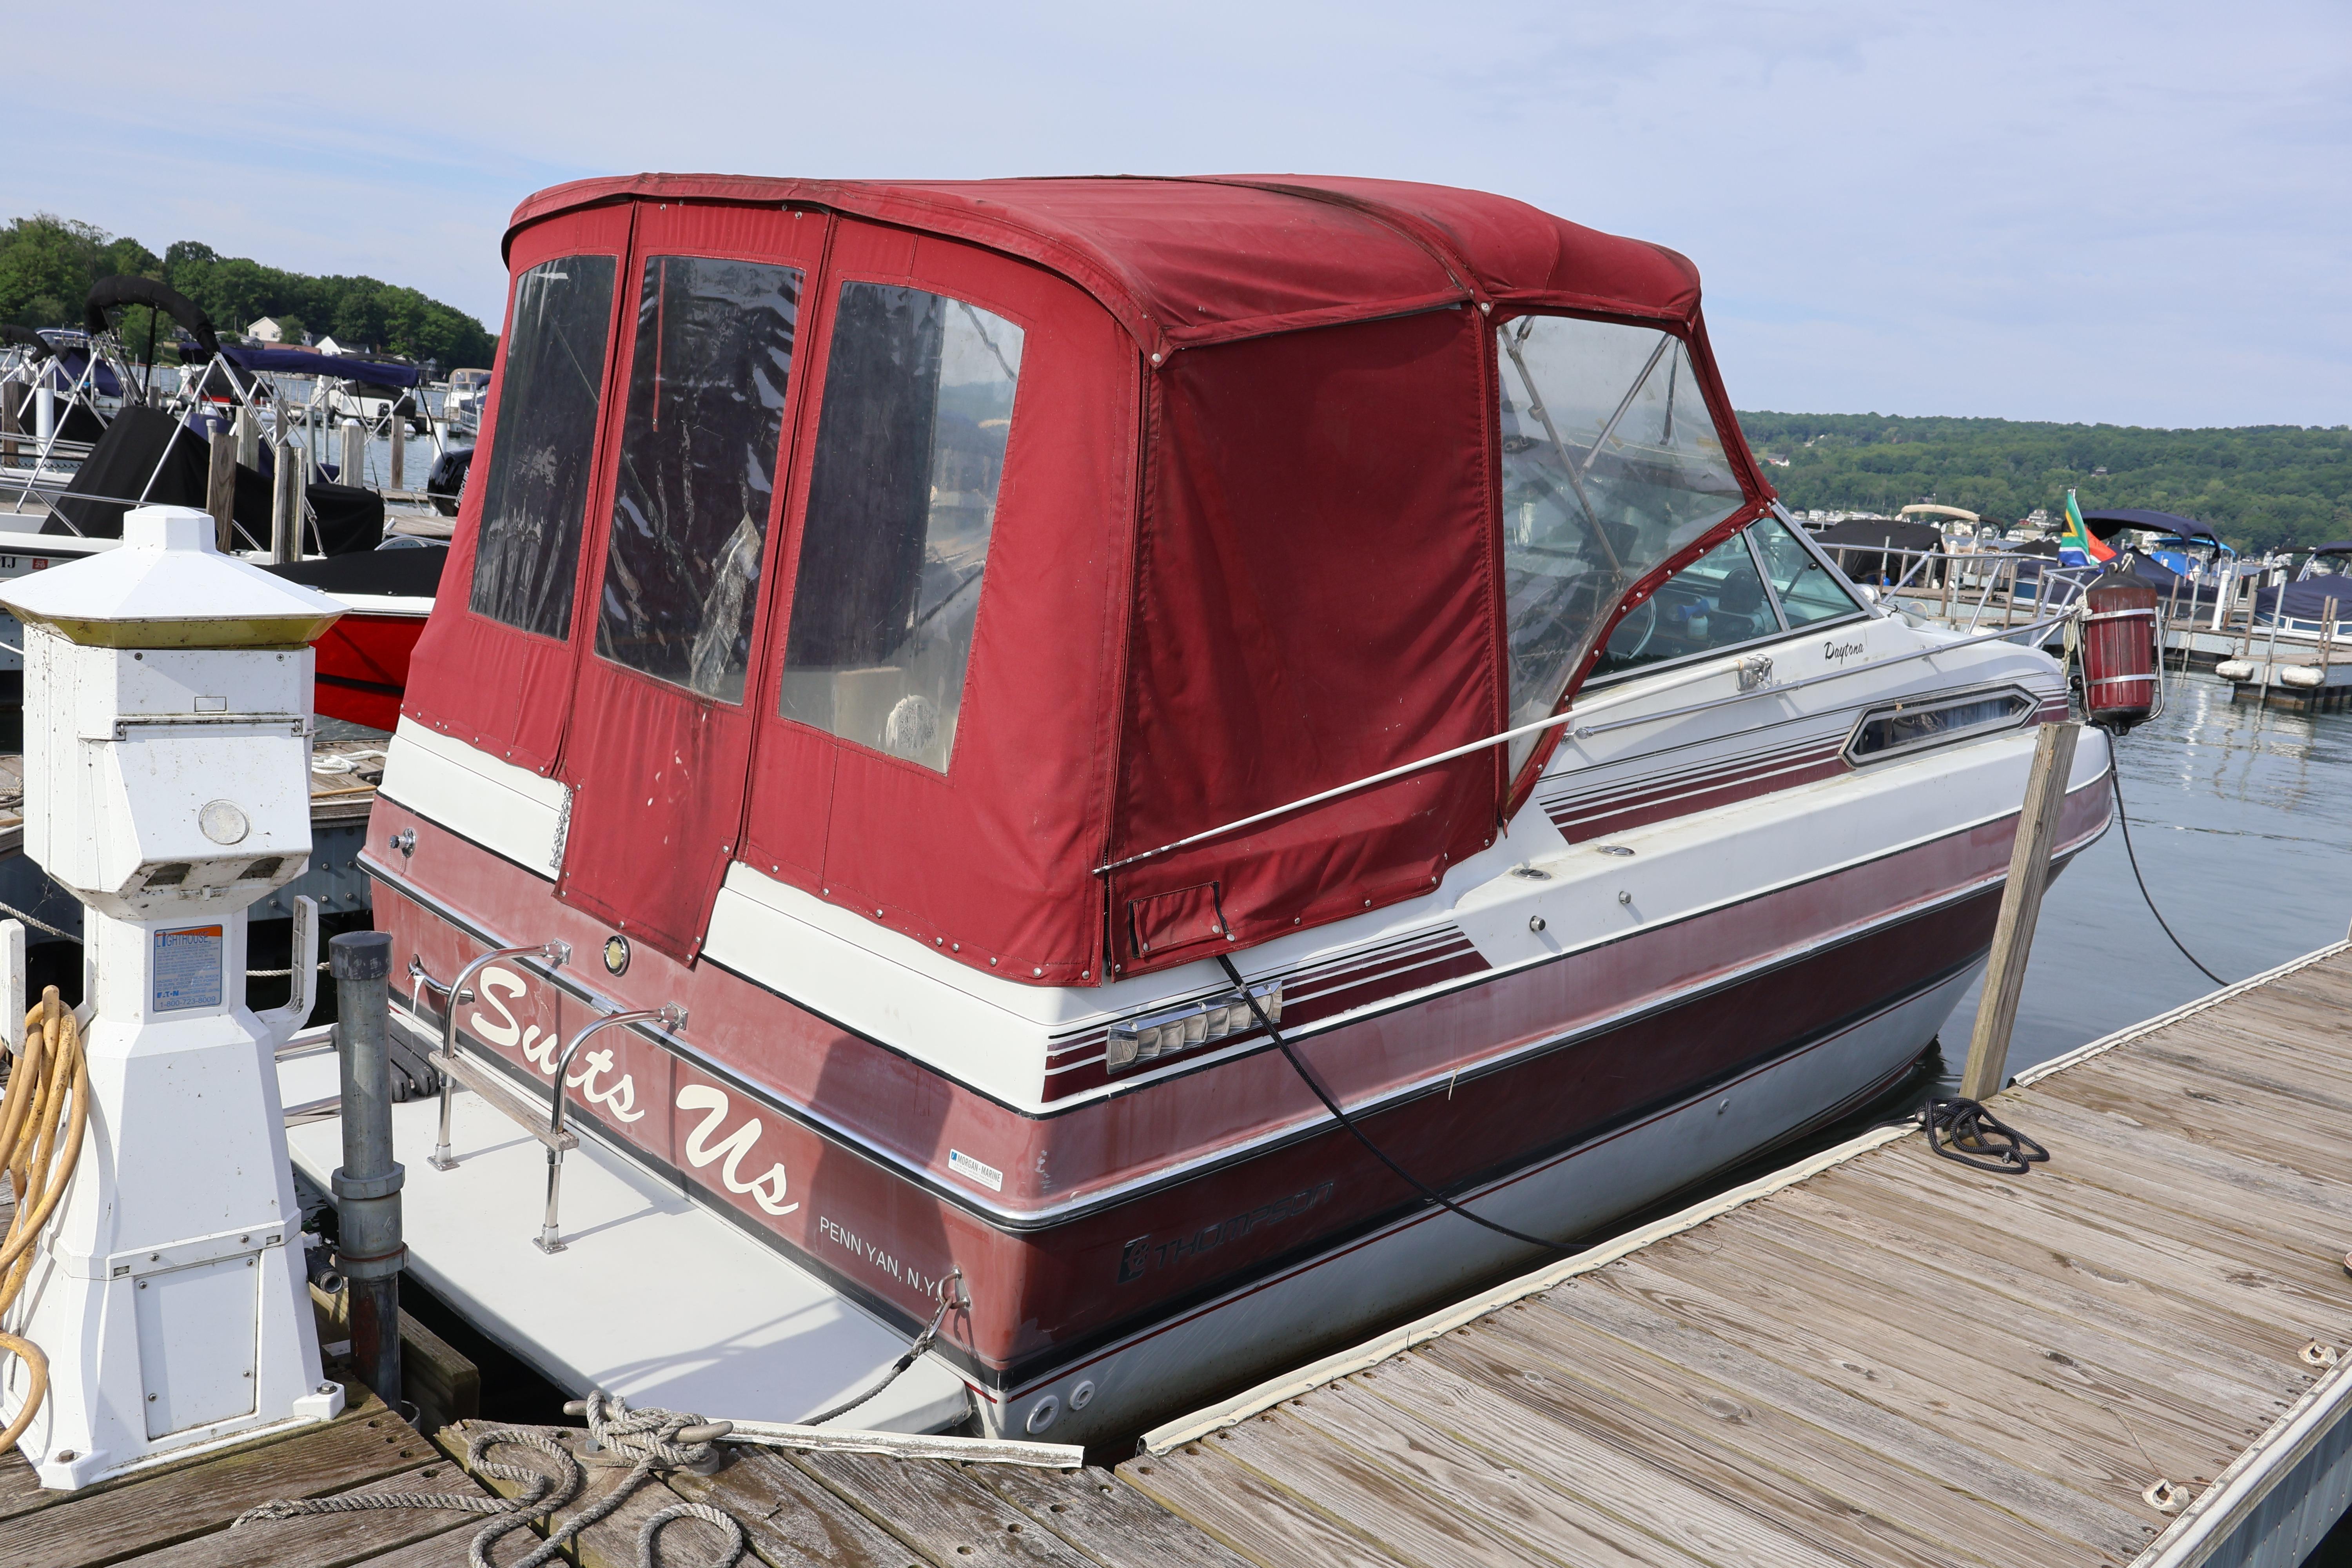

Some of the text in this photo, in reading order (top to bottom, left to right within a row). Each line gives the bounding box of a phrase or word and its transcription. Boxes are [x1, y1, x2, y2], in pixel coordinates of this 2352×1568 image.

[454, 466, 470, 508] MERCURY
[1824, 641, 1864, 665] Daytona
[156, 931, 209, 947] LIGHTHOUSE
[160, 996, 216, 1007] 1-800-723-8009
[675, 1084, 799, 1216] Us
[957, 1154, 978, 1172] MORGAN
[981, 1166, 1001, 1182] MARINE
[1155, 1180, 1333, 1269] THOMPSON
[820, 1216, 938, 1301] PENN YAN, N.Y.
